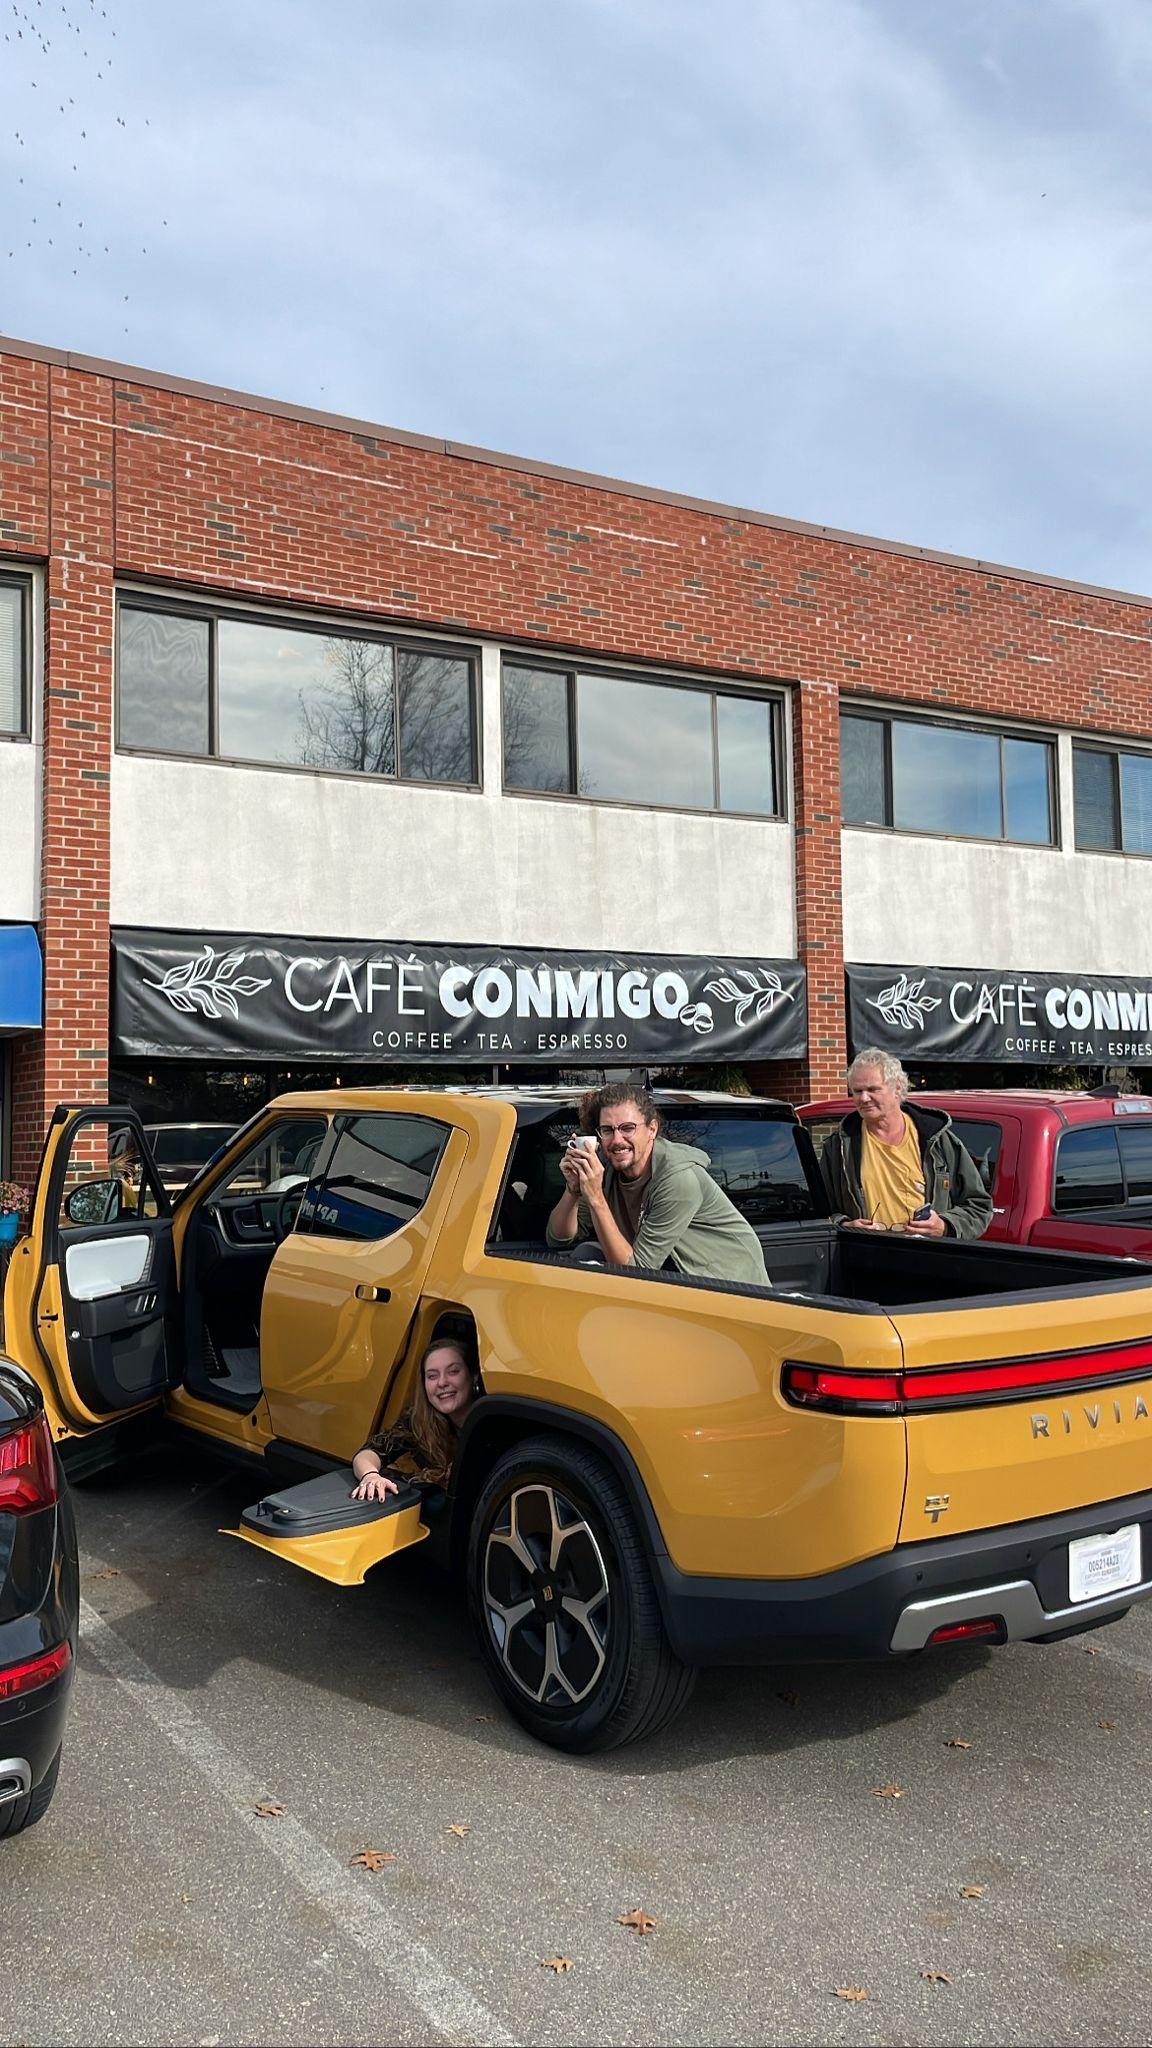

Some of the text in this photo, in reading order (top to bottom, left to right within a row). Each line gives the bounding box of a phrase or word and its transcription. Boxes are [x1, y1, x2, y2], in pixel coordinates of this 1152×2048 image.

[284, 953, 689, 1020] CAFÉ CONMIGO
[949, 977, 1037, 1026] CAFÉ
[372, 1030, 628, 1049] COFFEE TEA ESPRESSO
[1005, 1037, 1056, 1053] COFFEE
[1070, 1041, 1094, 1055] TEA
[1031, 1396, 1149, 1439] RIVIA
